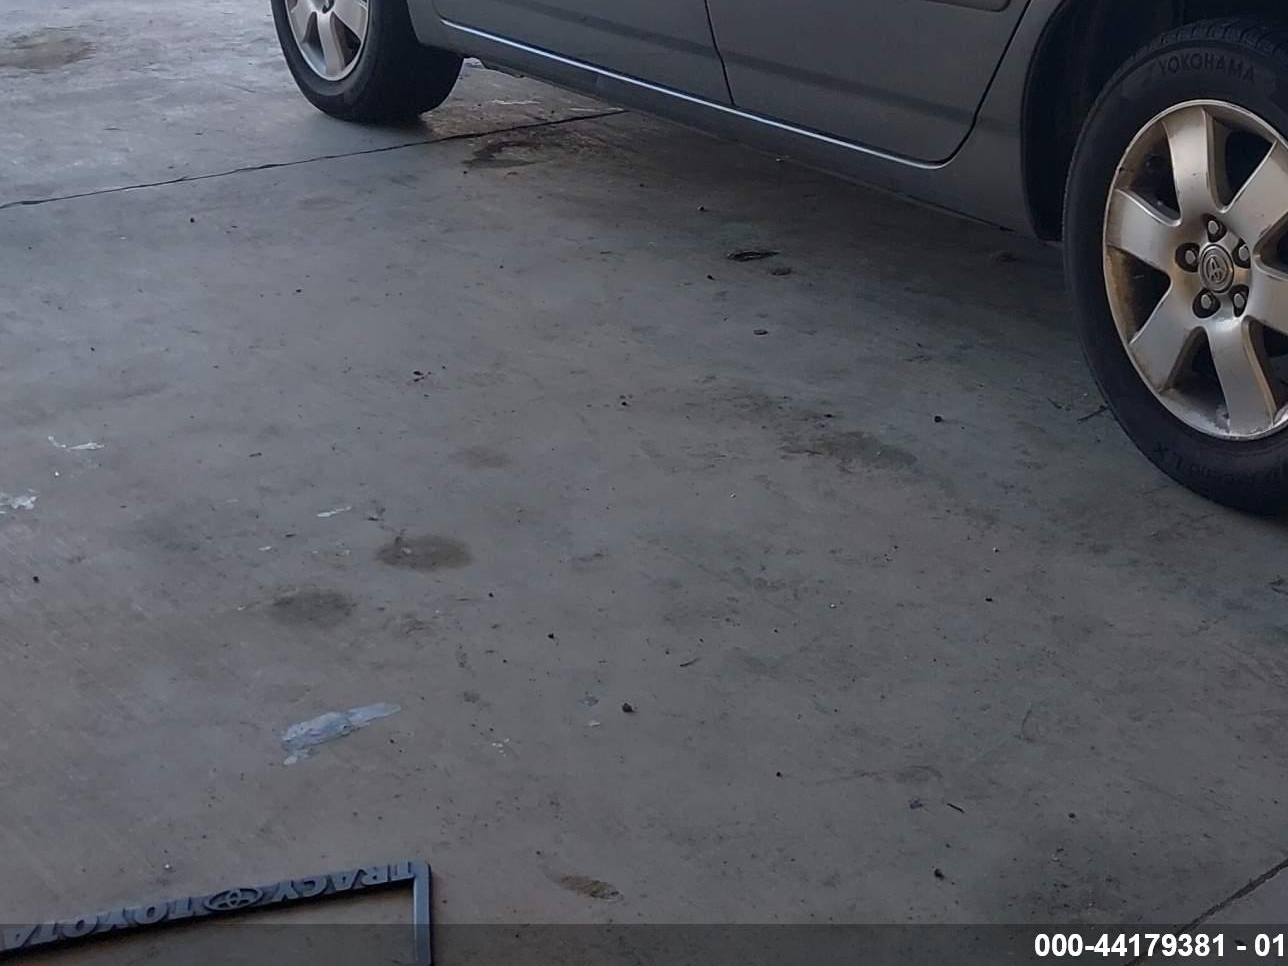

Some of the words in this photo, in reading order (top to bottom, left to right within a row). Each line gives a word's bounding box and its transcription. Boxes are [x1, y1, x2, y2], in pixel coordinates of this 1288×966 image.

[1157, 51, 1256, 83] YOKOHAMA
[273, 859, 414, 902] TRACY
[0, 899, 202, 950] TOYOTA
